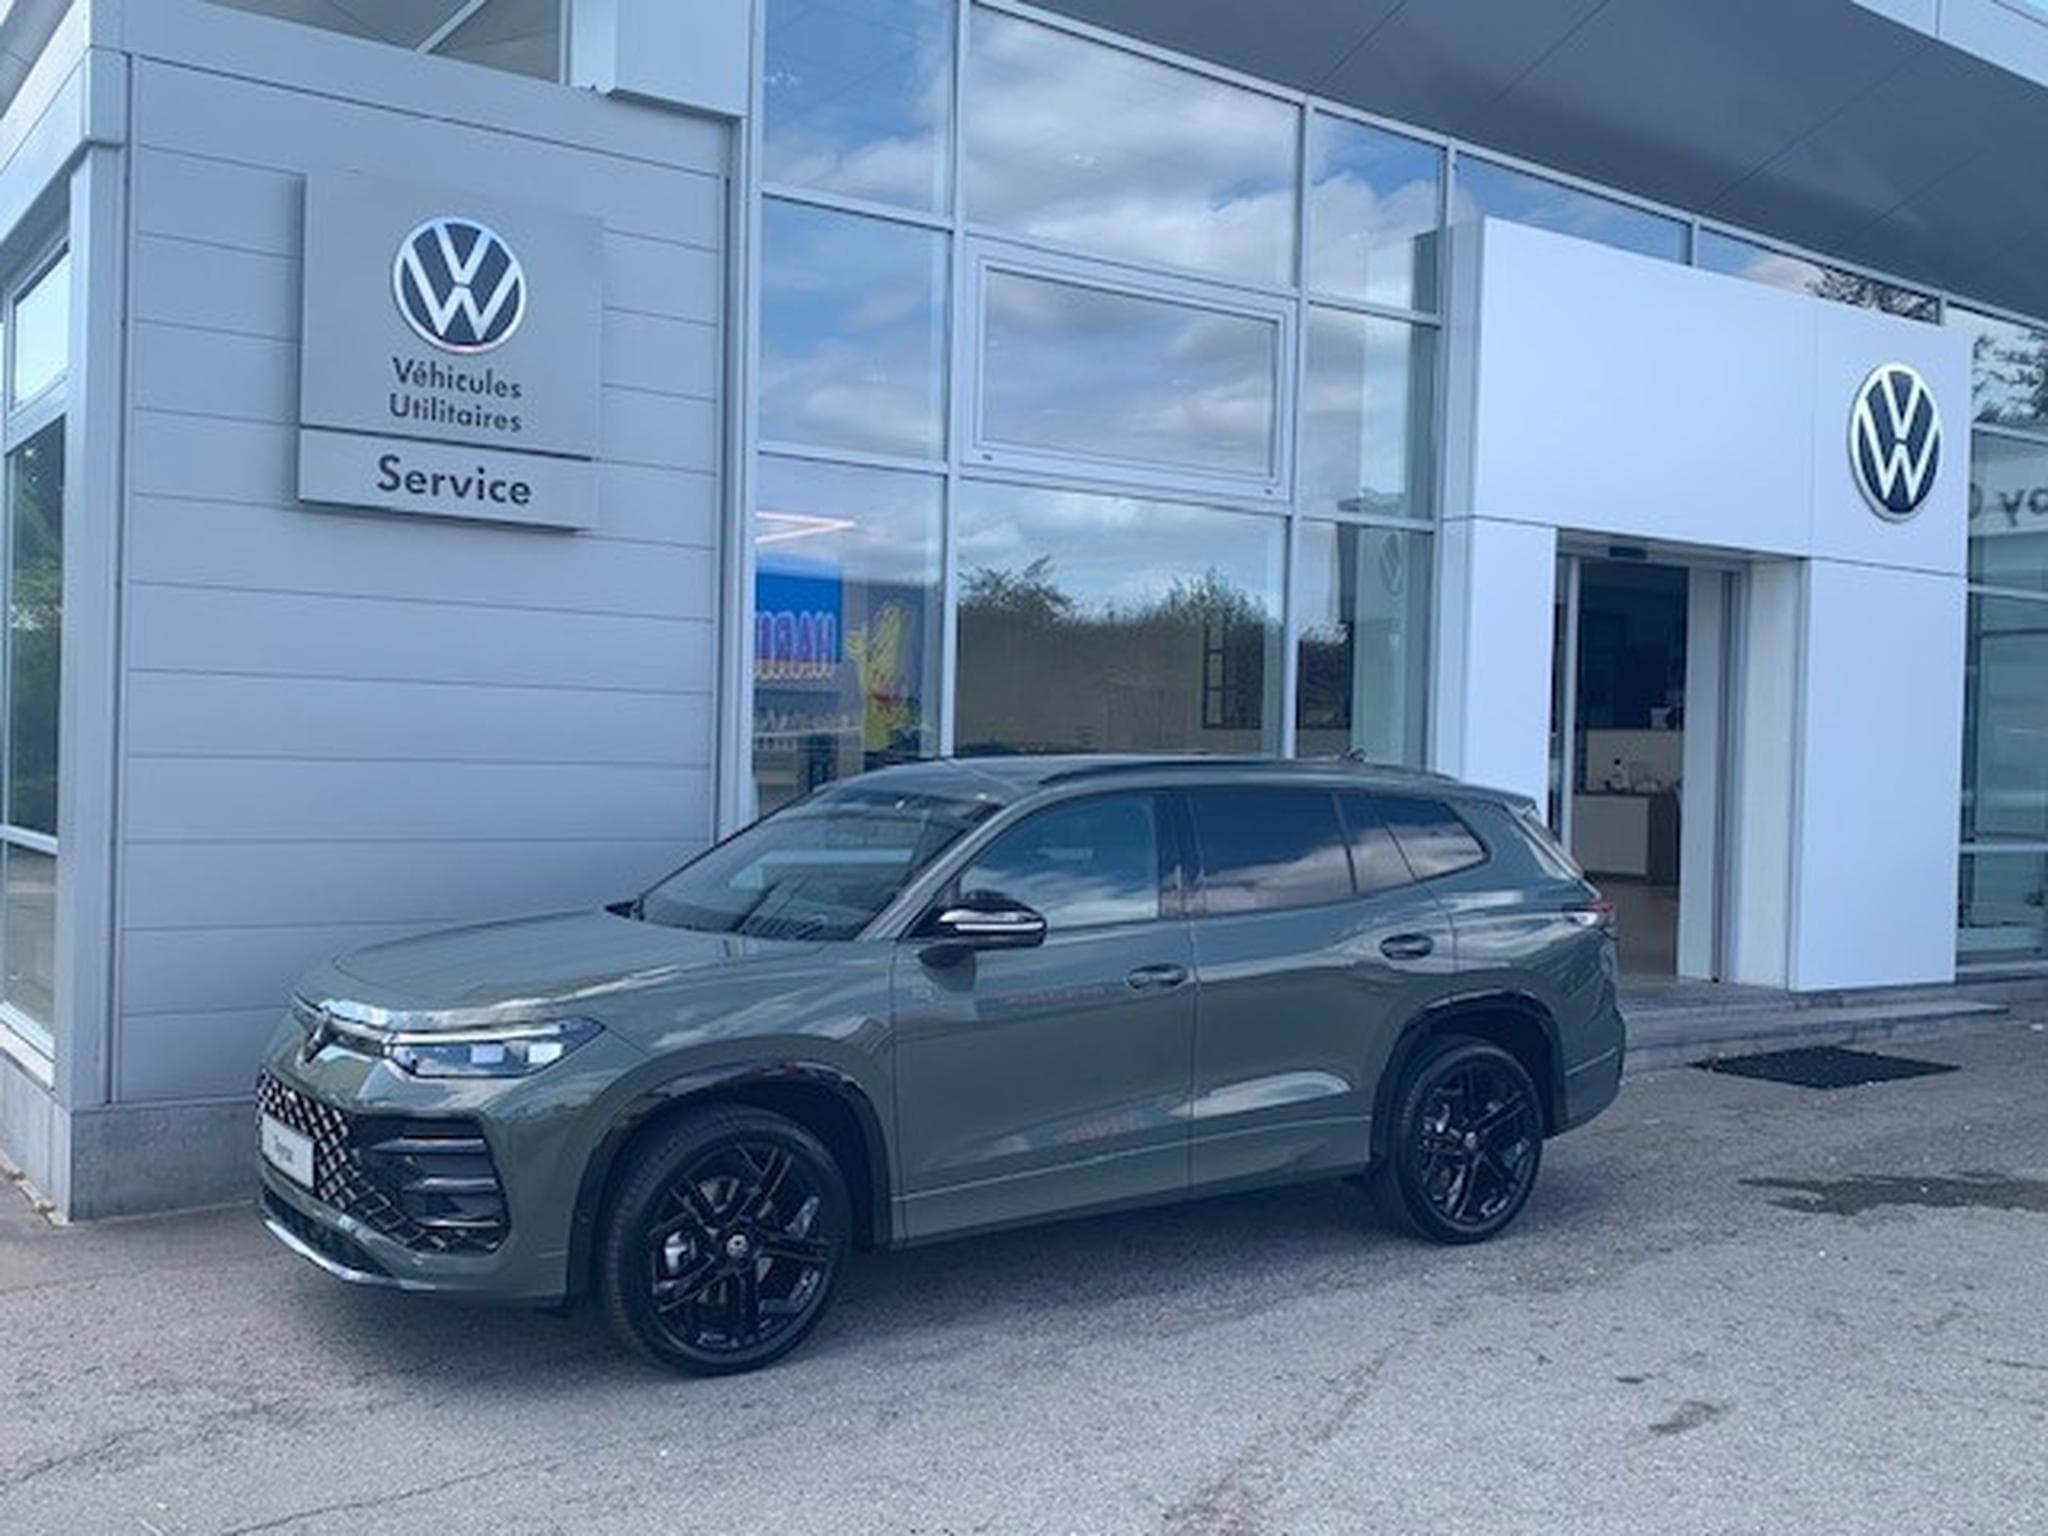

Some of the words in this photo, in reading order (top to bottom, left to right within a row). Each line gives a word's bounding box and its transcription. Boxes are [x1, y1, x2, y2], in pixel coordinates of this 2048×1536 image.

[392, 356, 522, 399] Véhicules
[389, 393, 522, 432] Utilitaires
[377, 454, 532, 506] Service
